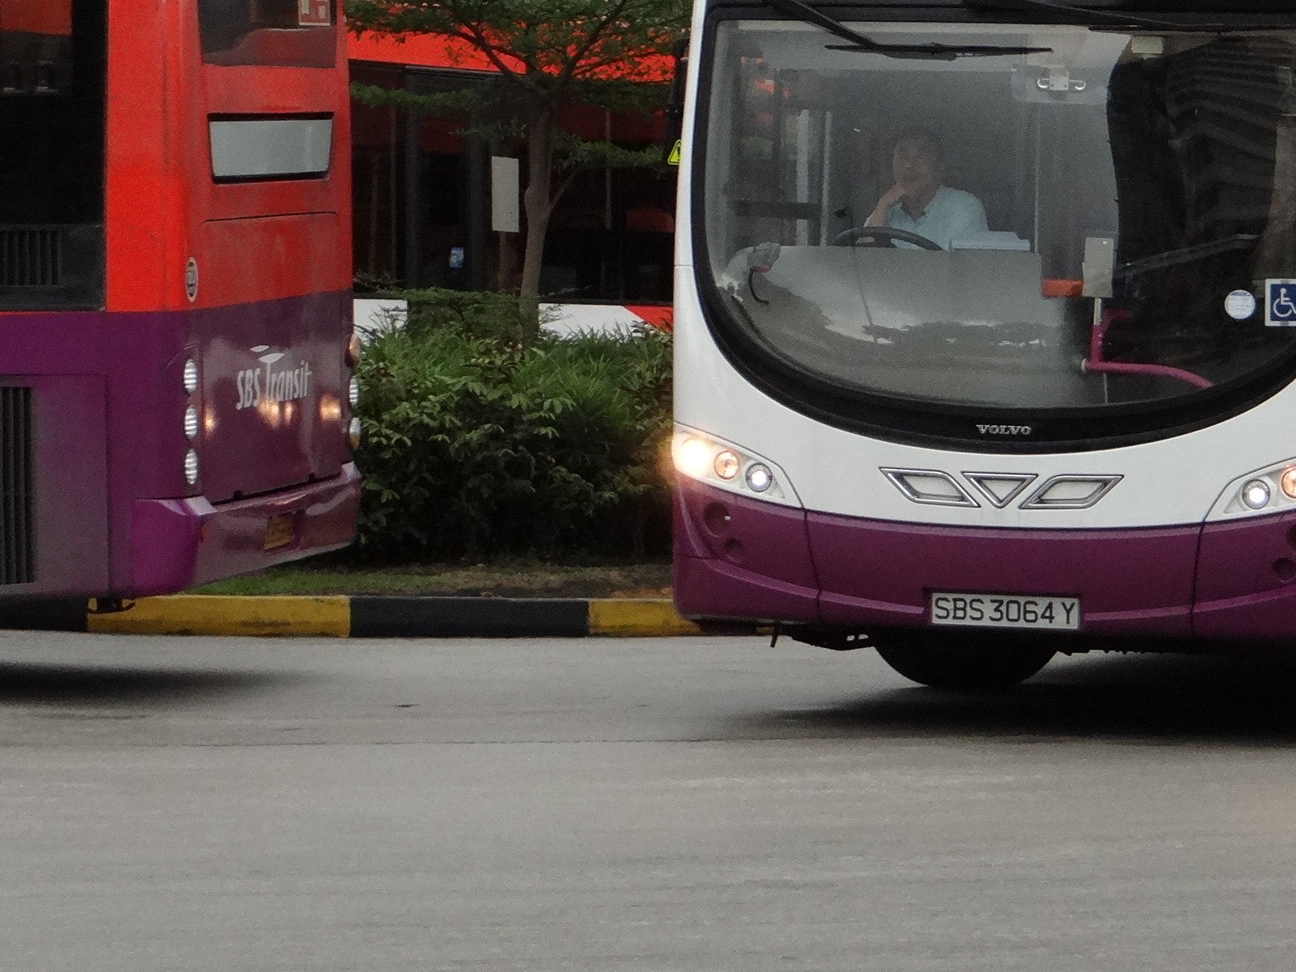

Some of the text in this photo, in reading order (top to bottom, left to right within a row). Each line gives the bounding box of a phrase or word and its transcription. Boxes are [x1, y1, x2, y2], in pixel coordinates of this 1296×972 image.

[235, 352, 313, 410] SBS Transit
[976, 424, 1032, 436] VOLVO
